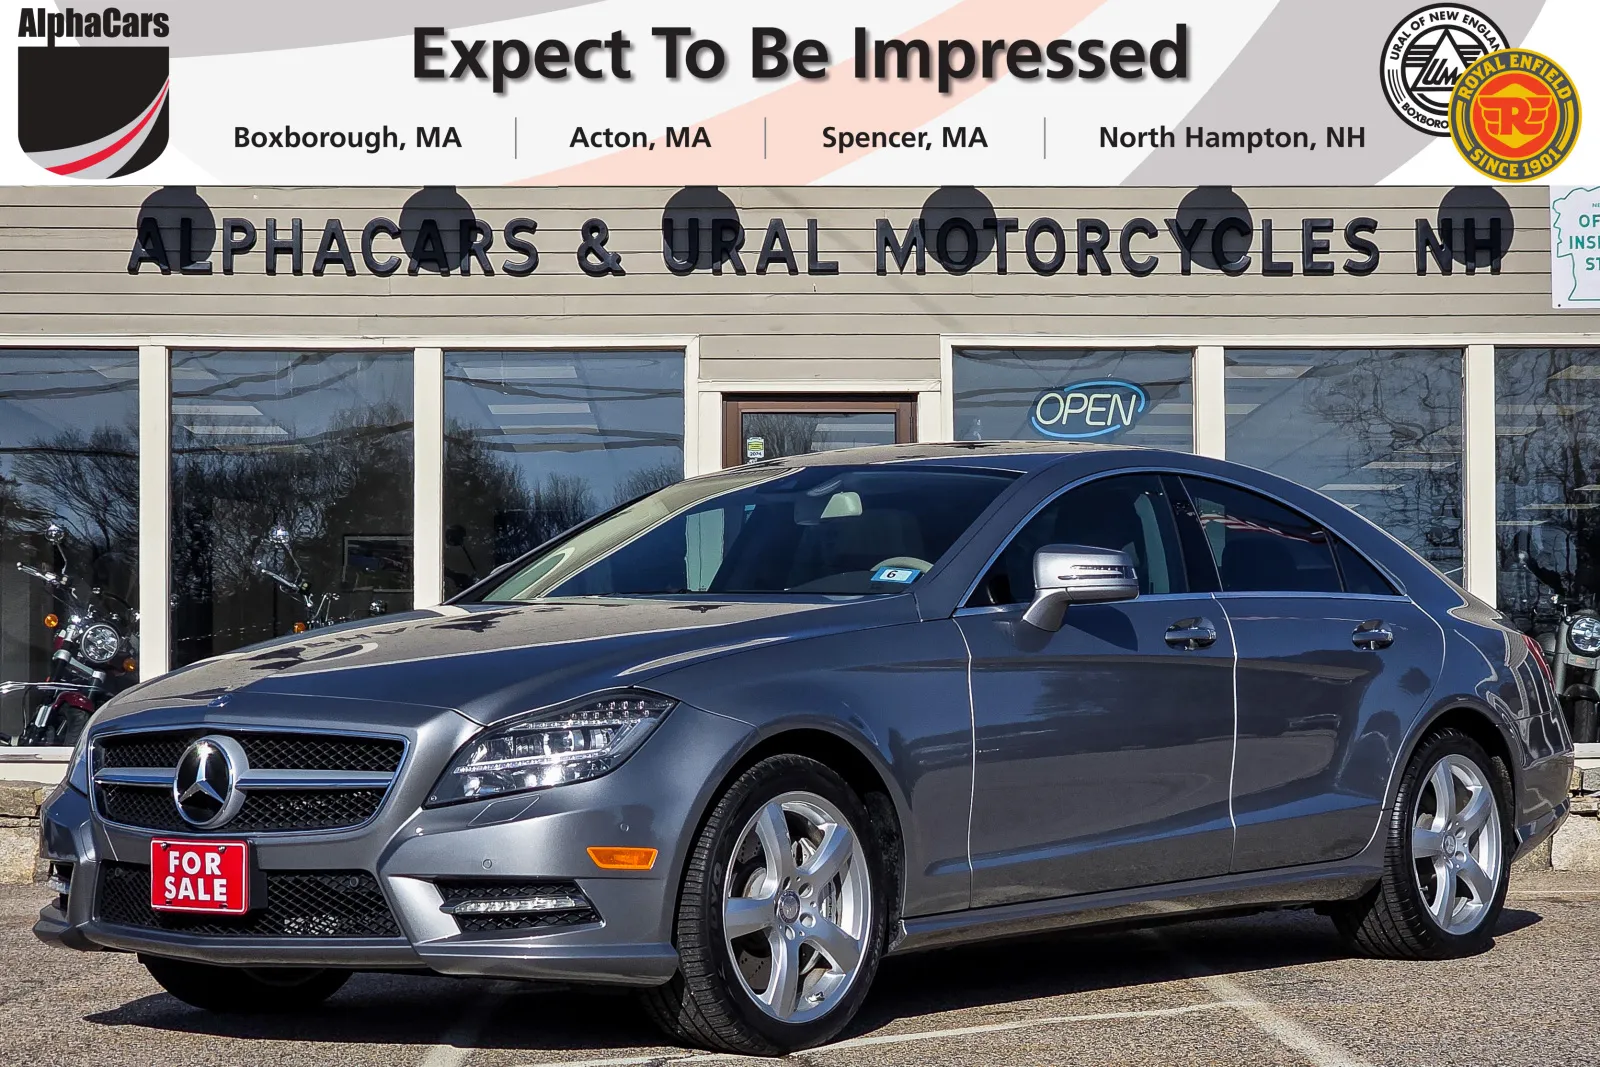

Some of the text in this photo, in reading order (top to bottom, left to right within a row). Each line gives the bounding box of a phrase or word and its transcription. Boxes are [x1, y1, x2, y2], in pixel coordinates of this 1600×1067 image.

[127, 217, 1501, 277] ALPHACARS & URAL MOTORCYCLES NH
[1036, 392, 1136, 426] OPEN
[886, 570, 898, 579] 6
[169, 851, 221, 875] FOR
[164, 876, 227, 901] SALE
